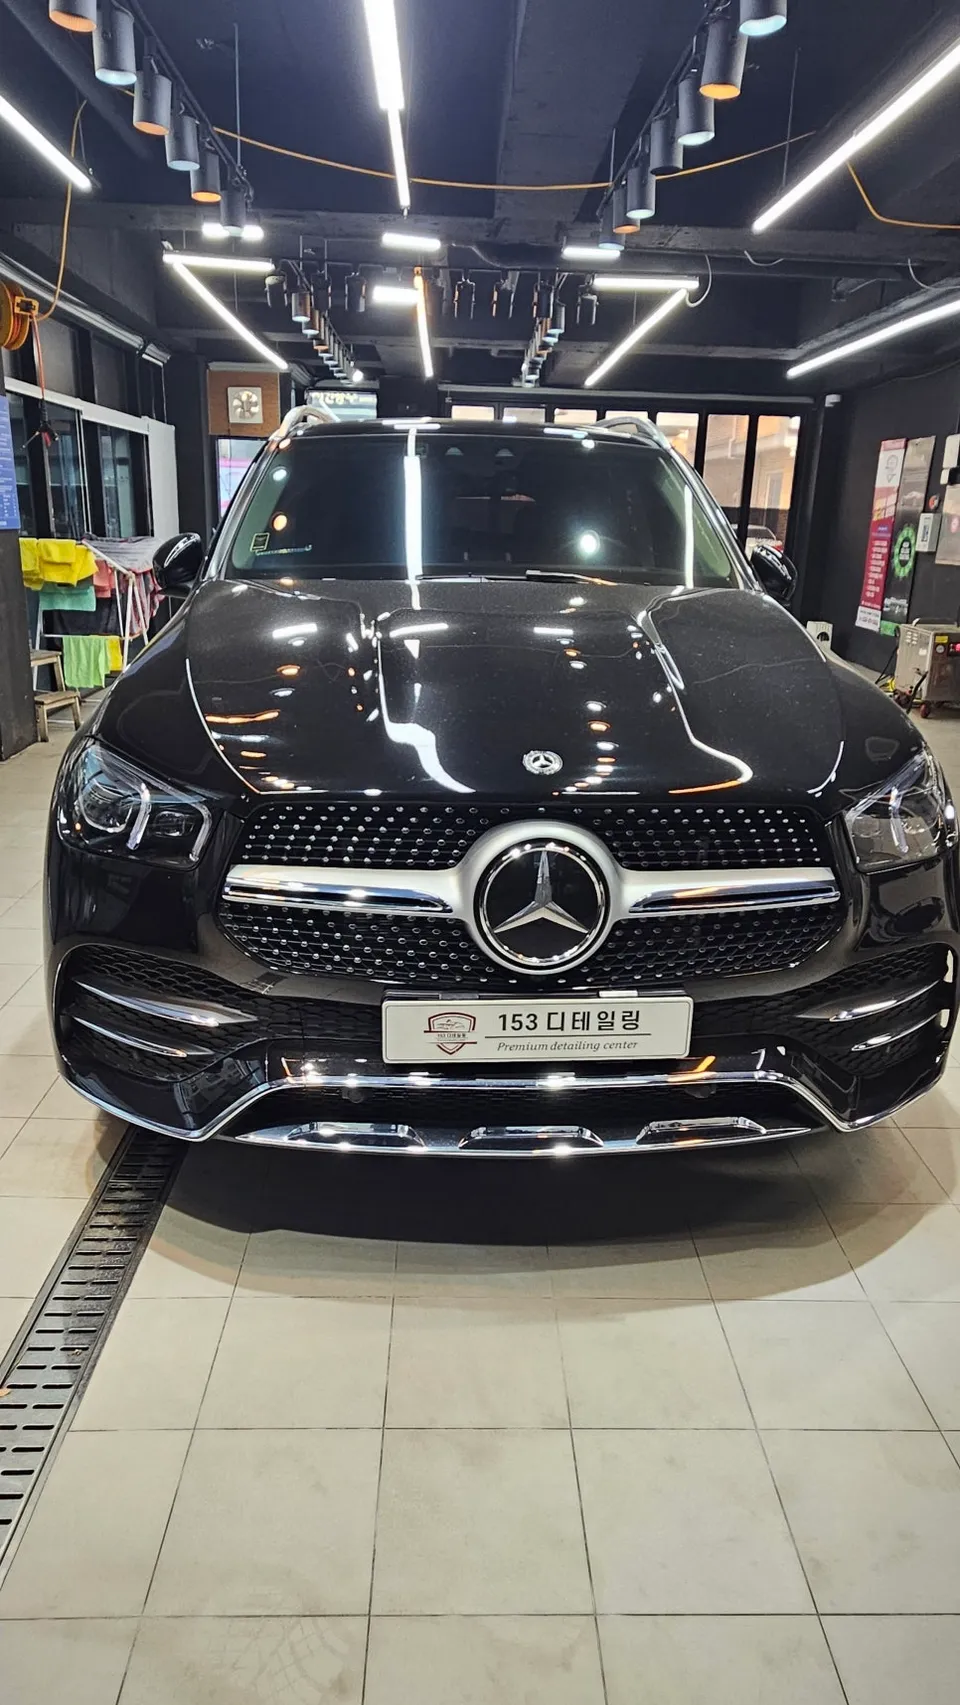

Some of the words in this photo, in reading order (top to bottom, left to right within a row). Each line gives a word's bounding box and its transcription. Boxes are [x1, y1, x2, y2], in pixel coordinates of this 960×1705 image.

[498, 1013, 538, 1031] 153
[546, 1010, 640, 1031] 디테일링
[497, 1042, 548, 1051] Premium
[550, 1040, 600, 1052] detailing
[602, 1040, 638, 1050] center
